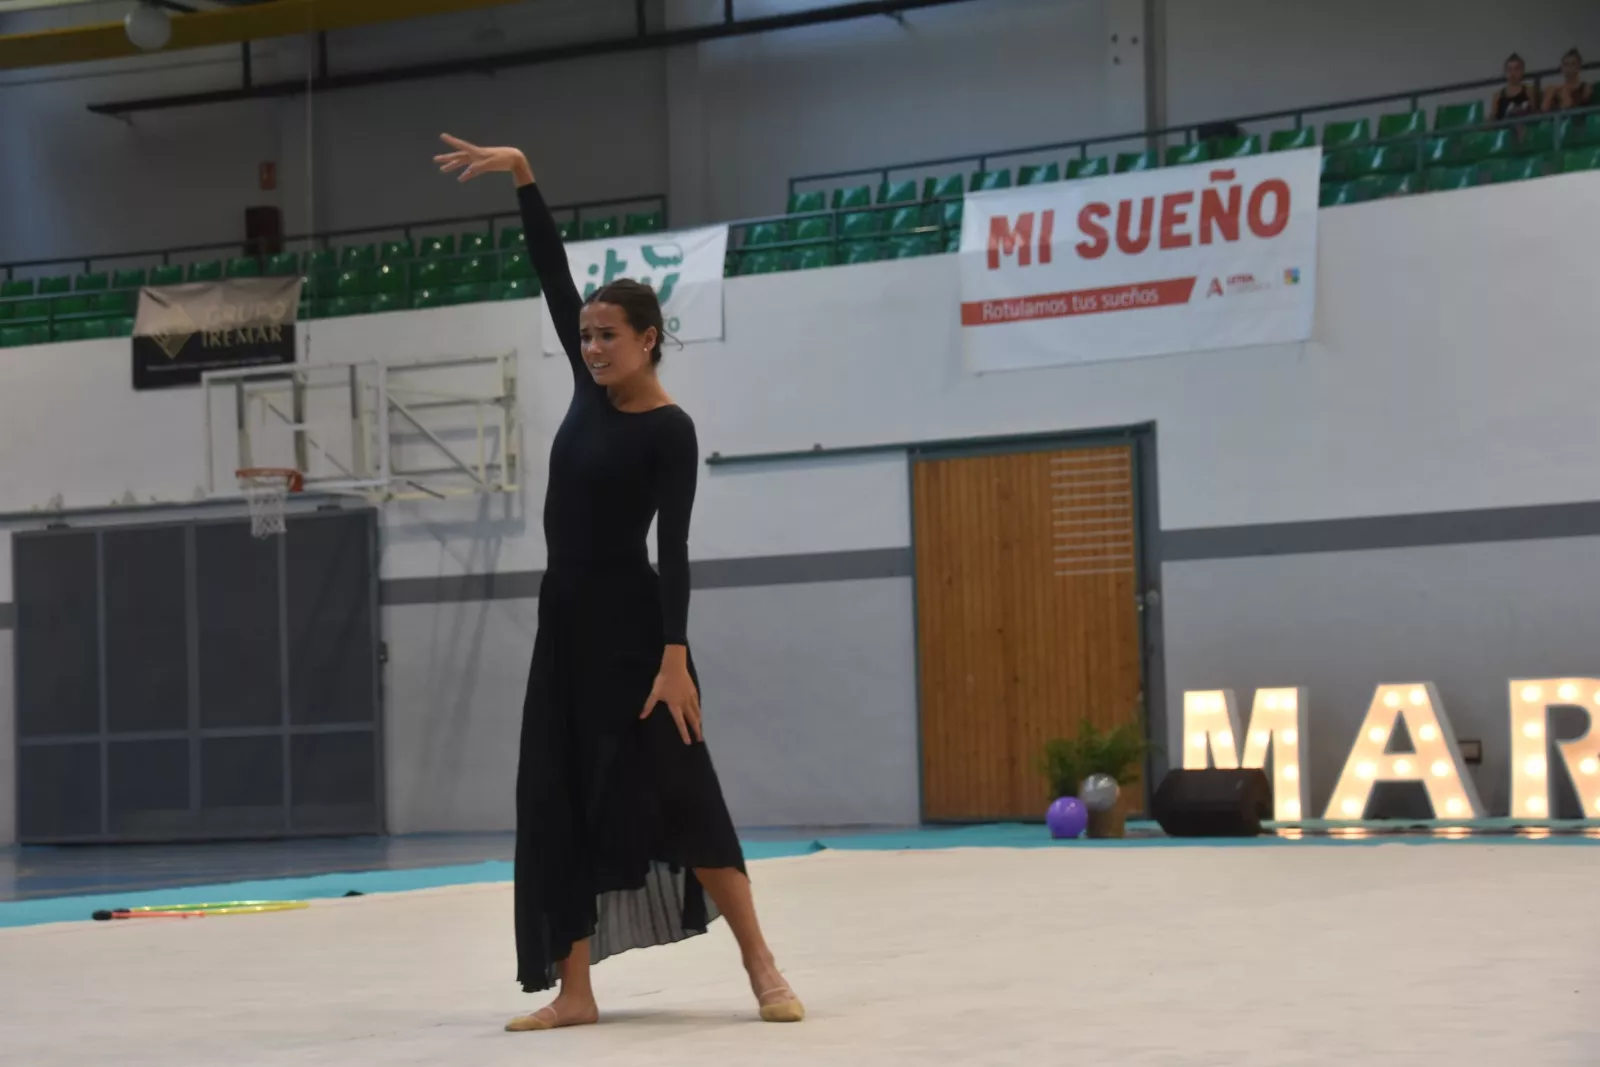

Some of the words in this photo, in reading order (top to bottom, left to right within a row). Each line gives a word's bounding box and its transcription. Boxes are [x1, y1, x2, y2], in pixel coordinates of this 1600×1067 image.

[987, 209, 1055, 271] MI
[1075, 169, 1292, 261] SUEÑO
[204, 300, 287, 325] GRUPO
[982, 297, 1067, 321] Rotulamos
[1072, 295, 1097, 312] tus
[1102, 287, 1159, 308] sueños
[1183, 677, 1600, 821] MAR
